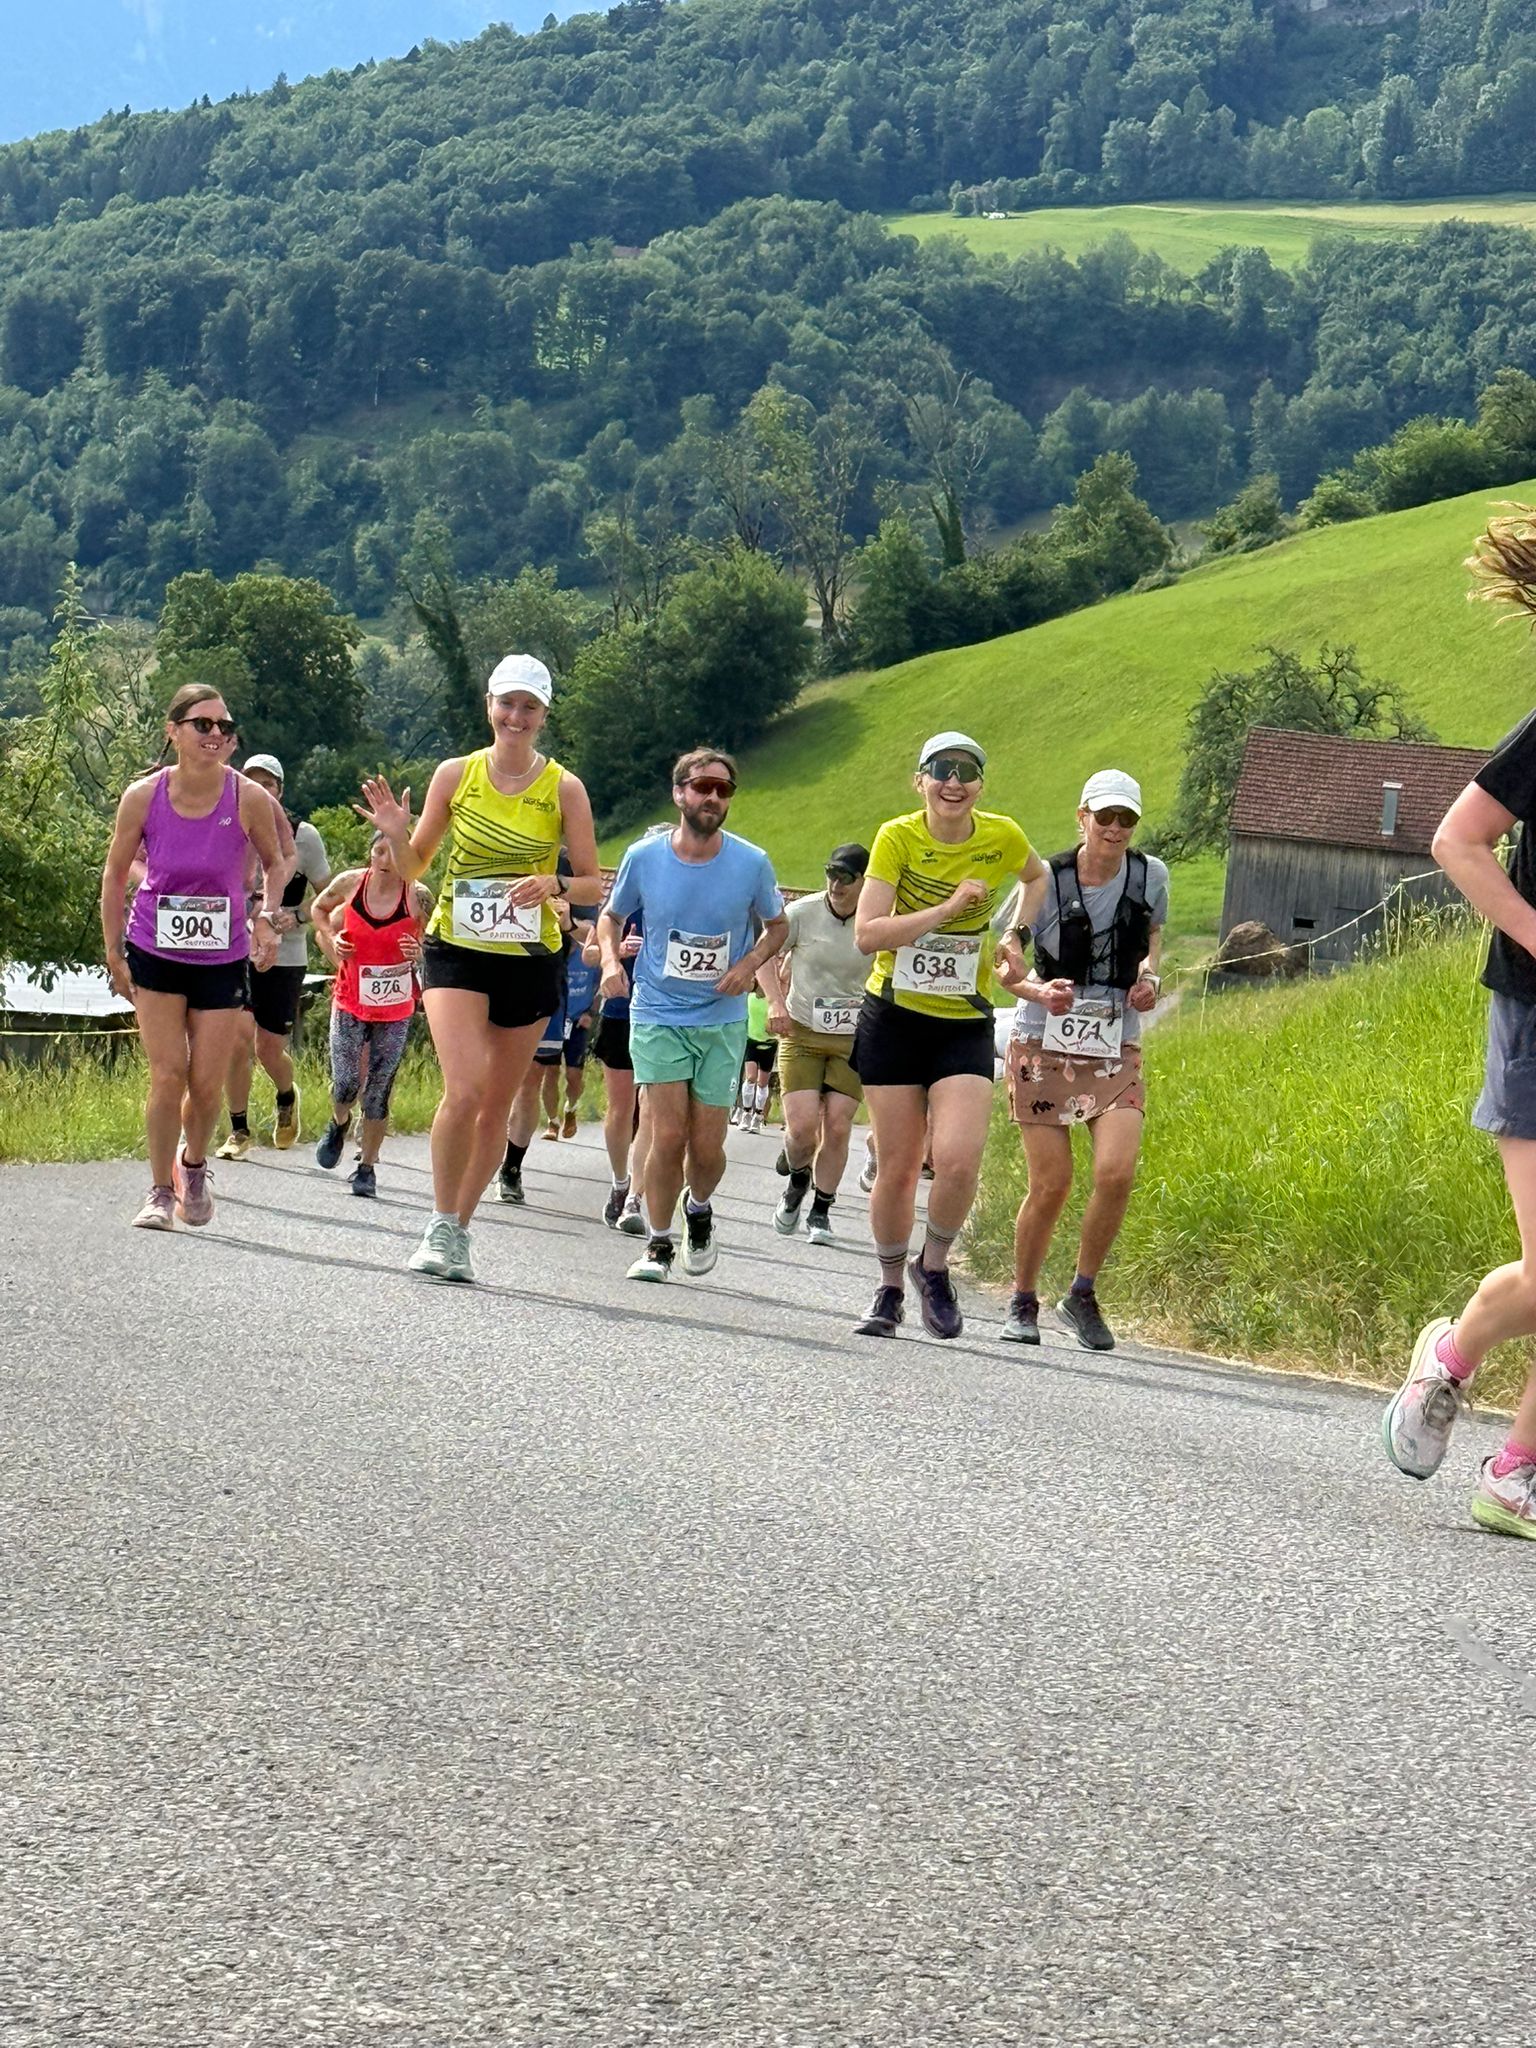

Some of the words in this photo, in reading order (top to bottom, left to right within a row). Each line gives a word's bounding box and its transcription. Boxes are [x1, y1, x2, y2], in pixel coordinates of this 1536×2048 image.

[470, 901, 516, 924] 814
[171, 915, 213, 938] 900
[680, 949, 716, 972] 922
[912, 953, 957, 978] 638
[371, 979, 400, 995] 876
[823, 1010, 851, 1024] 812
[1061, 1017, 1100, 1040] 671
